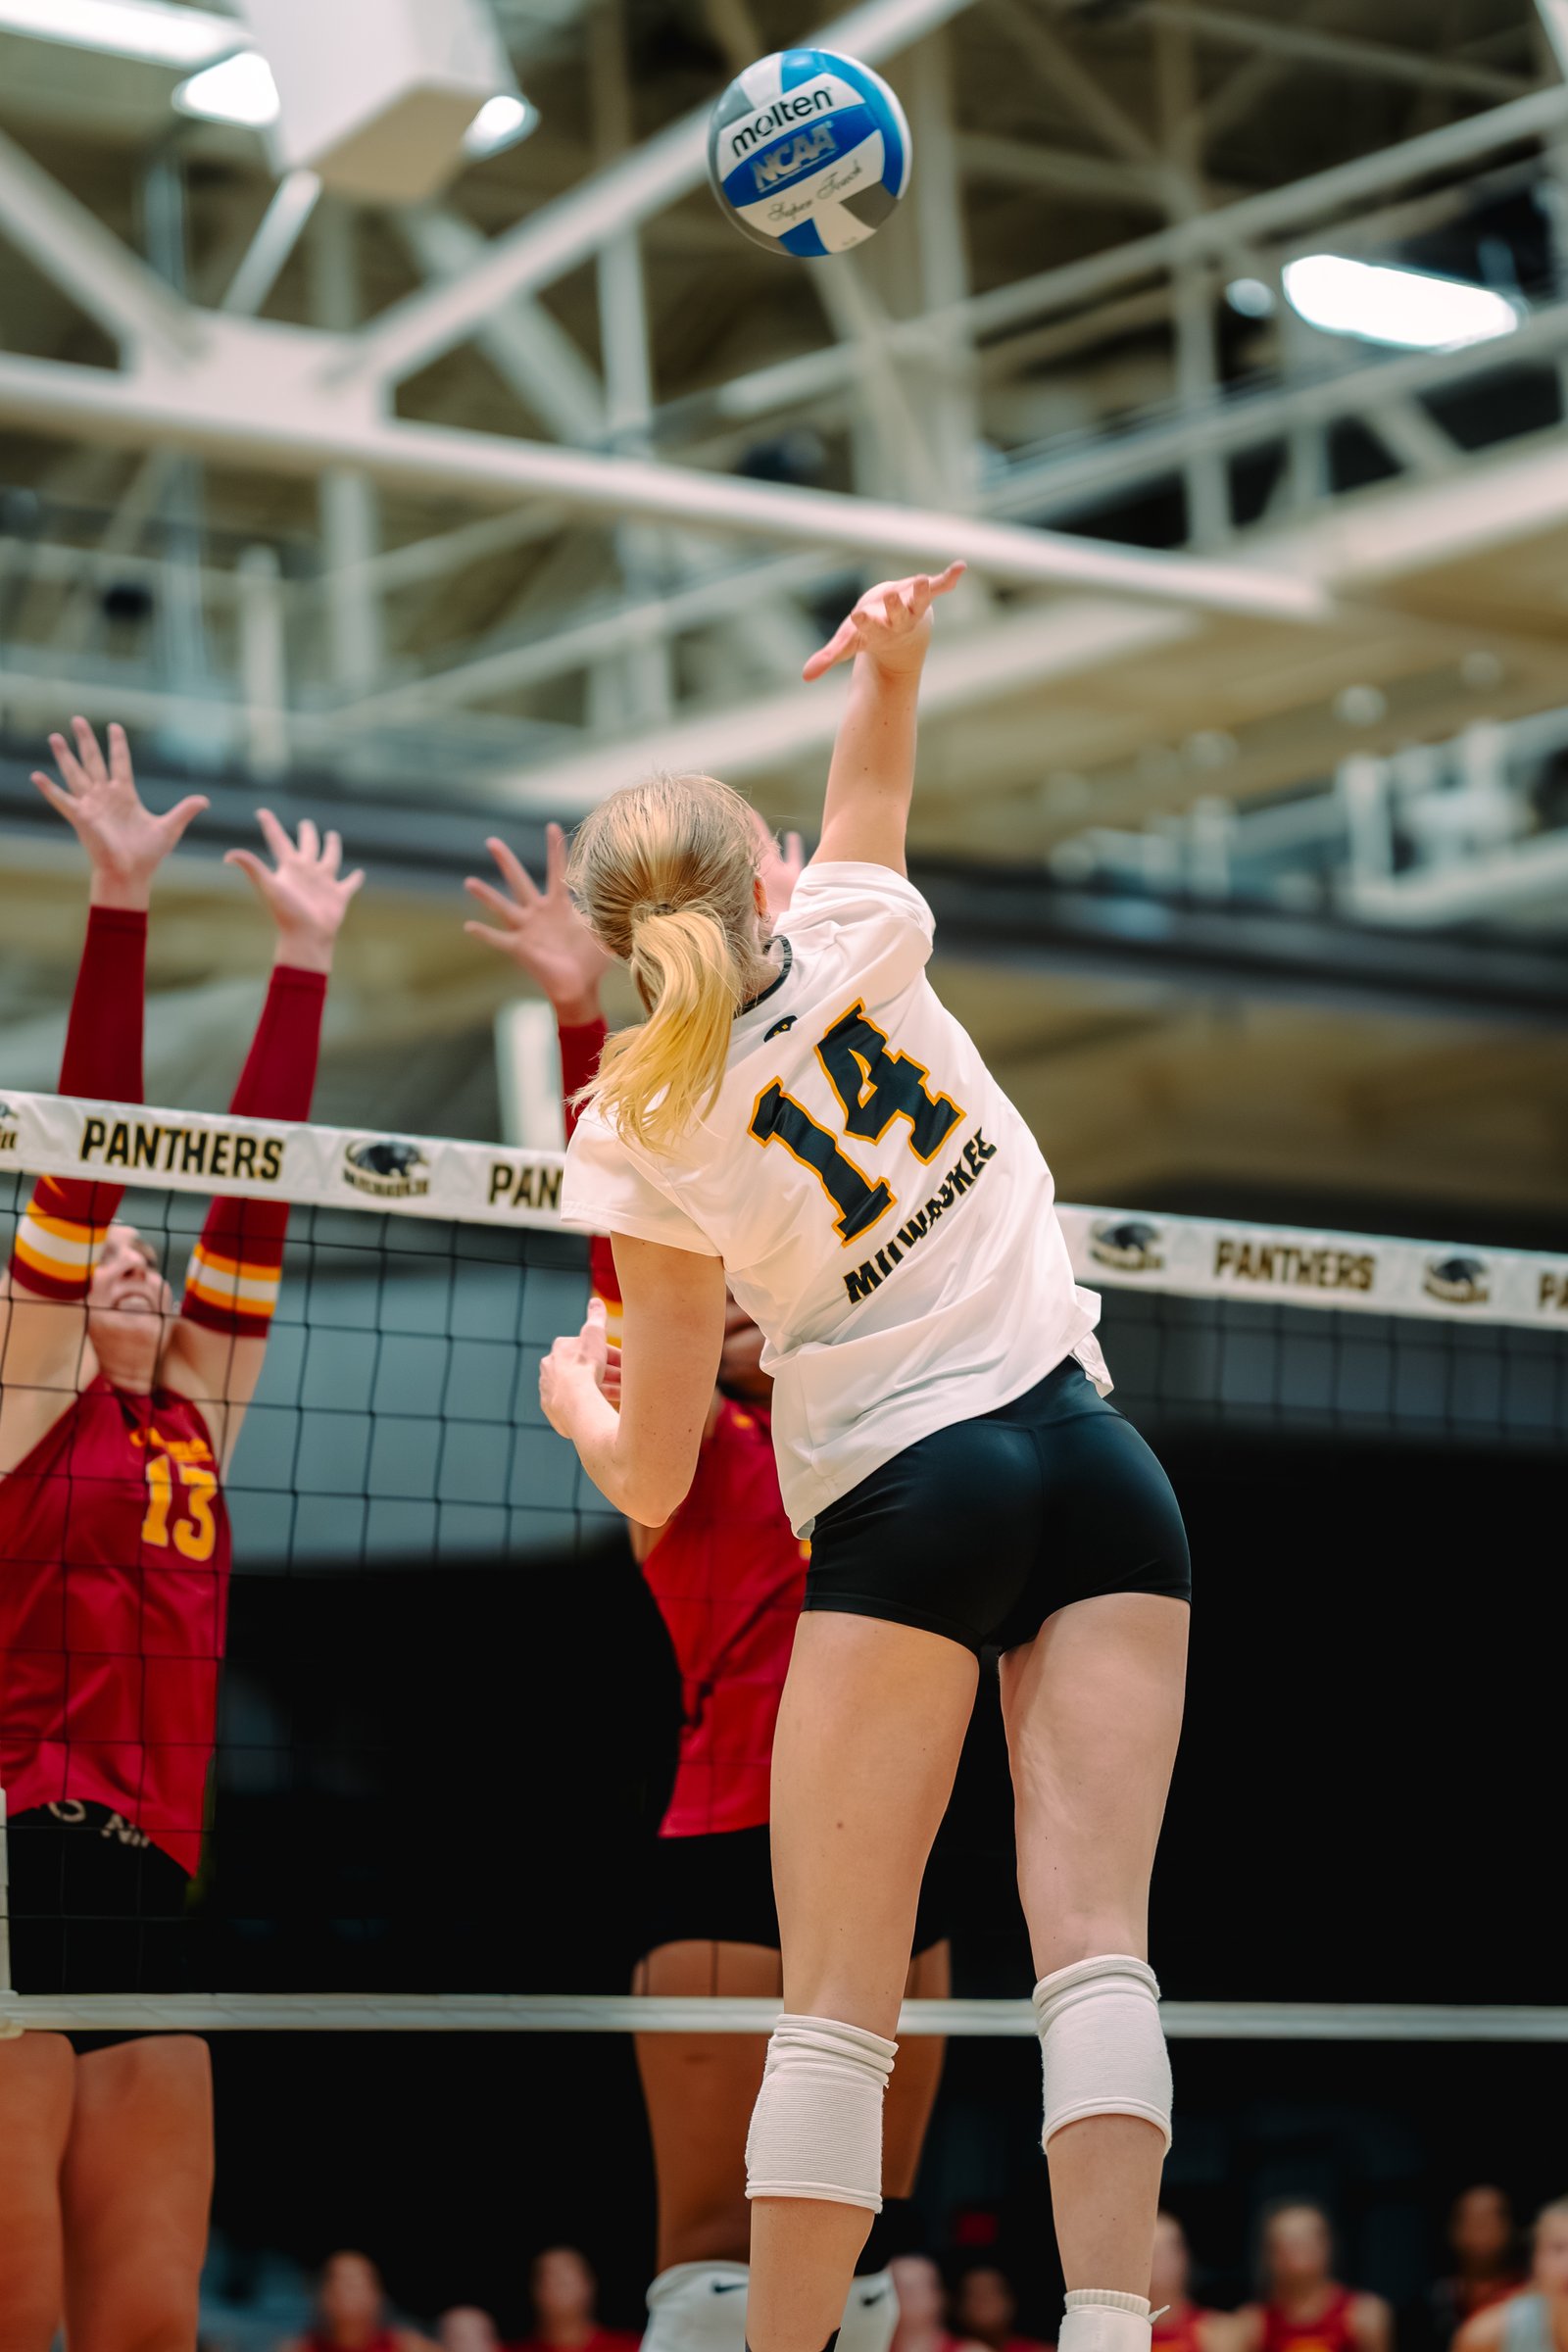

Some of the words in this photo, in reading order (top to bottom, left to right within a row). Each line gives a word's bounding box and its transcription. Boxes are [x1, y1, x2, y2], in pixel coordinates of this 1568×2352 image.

[731, 90, 833, 157] molten
[749, 124, 837, 192] NCAA
[79, 1115, 284, 1181] PANTHERS
[747, 997, 967, 1248] 14
[1213, 1240, 1375, 1292] PANTHERS
[141, 1453, 218, 1562] 13
